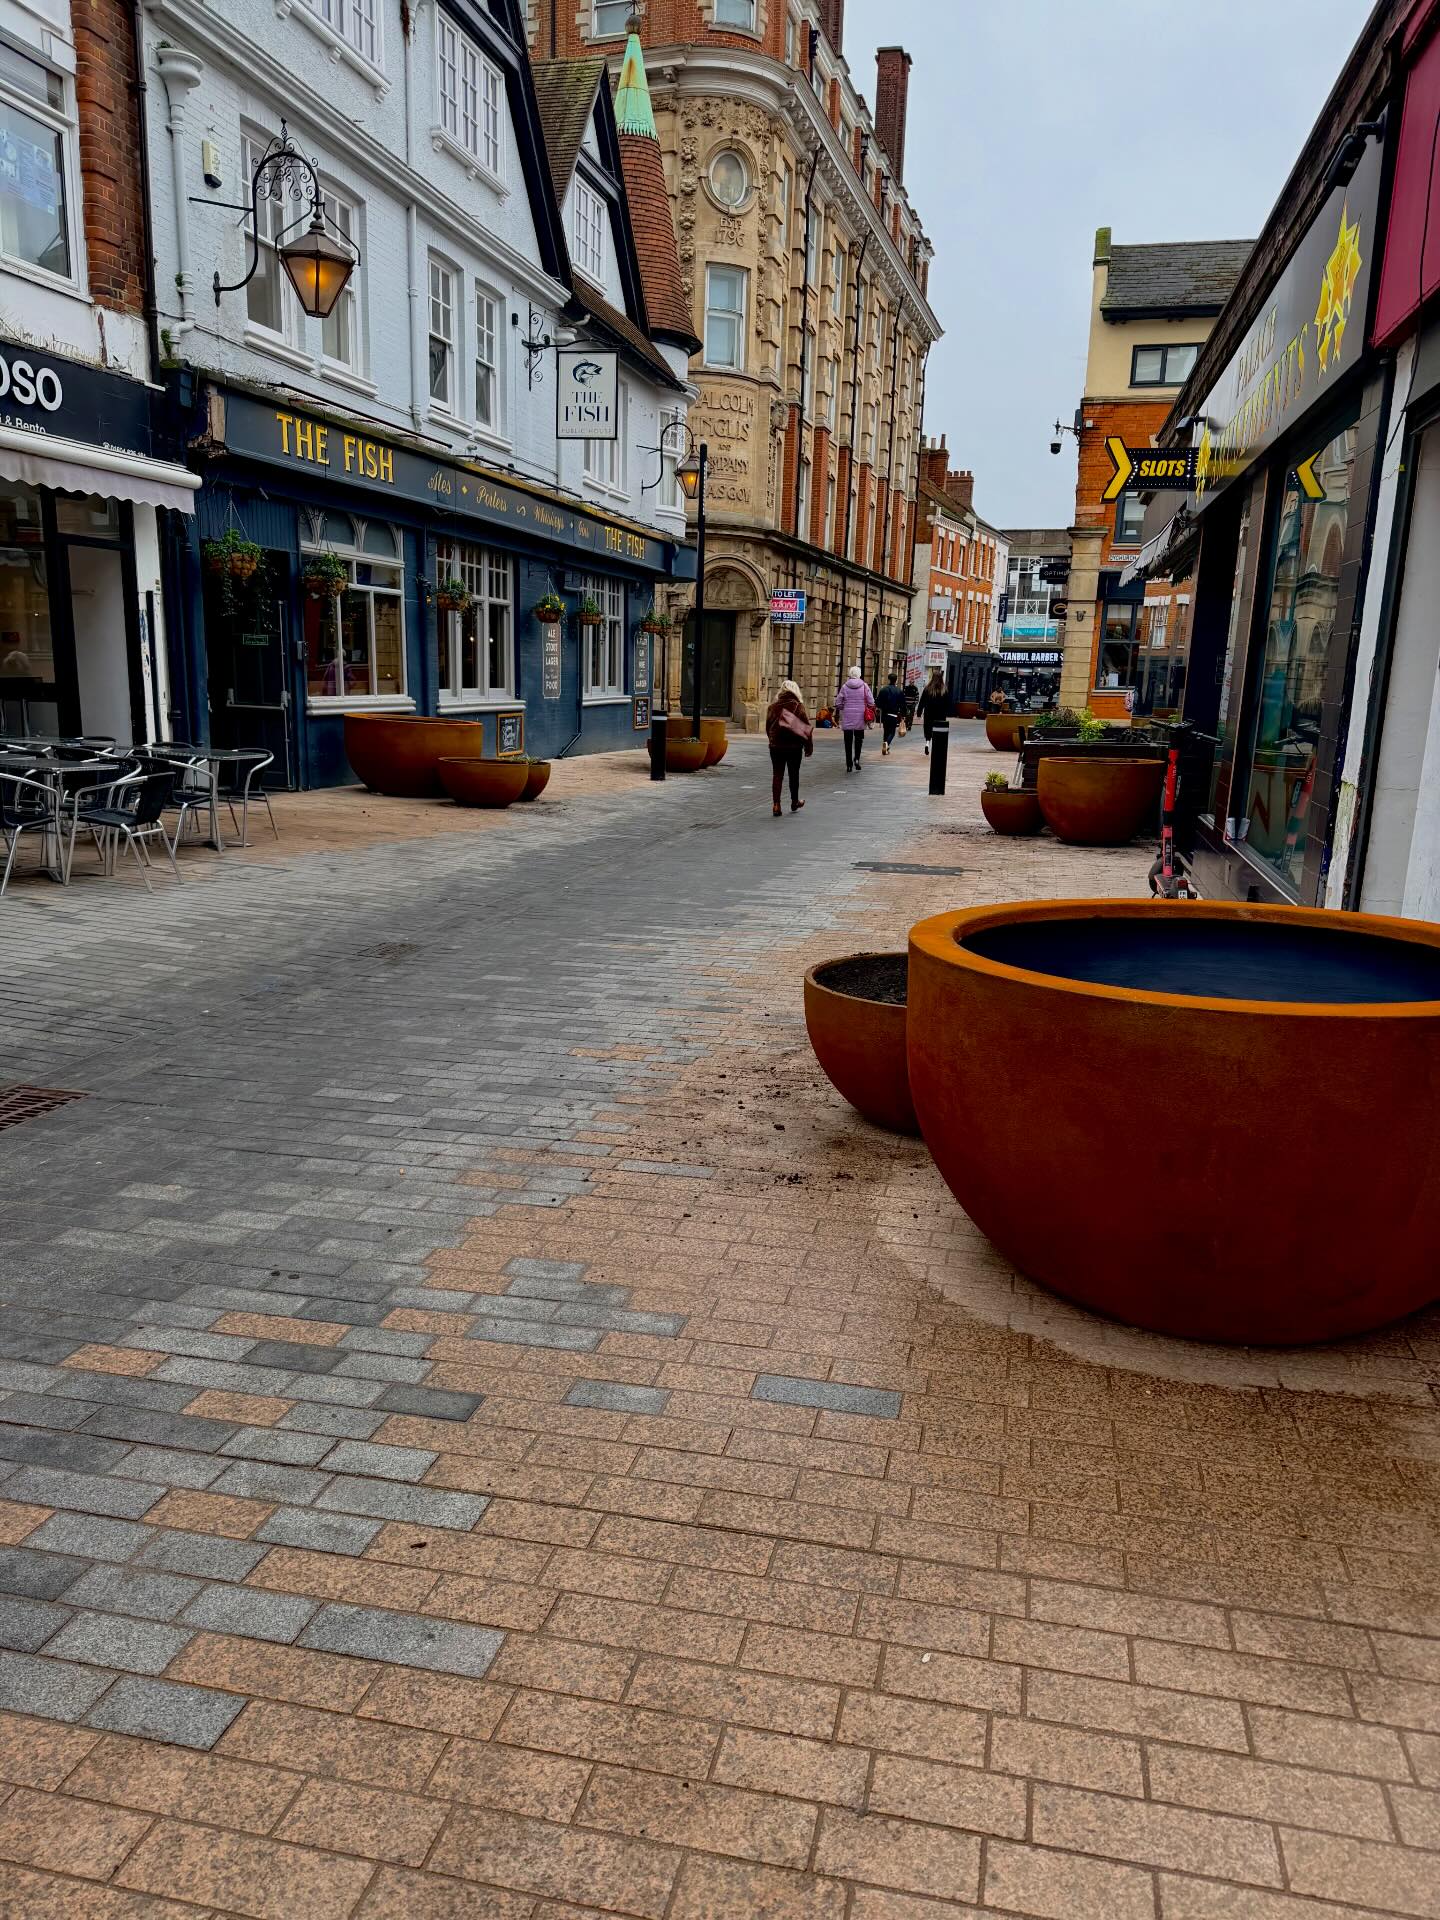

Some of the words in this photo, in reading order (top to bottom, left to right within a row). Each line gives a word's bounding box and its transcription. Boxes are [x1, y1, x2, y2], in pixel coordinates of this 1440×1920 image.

[714, 229, 744, 247] 1796
[571, 392, 602, 403] THE
[563, 406, 609, 421] FISH
[276, 412, 330, 465] THE
[344, 435, 394, 483] FISH
[1140, 460, 1186, 476] SLOTS
[605, 527, 622, 553] THE
[627, 533, 645, 560] FISH
[547, 629, 556, 638] ALE
[546, 642, 558, 652] STOUT
[545, 656, 559, 666] LAGER
[999, 653, 1030, 661] STANBUL
[1030, 653, 1059, 662] BARBER
